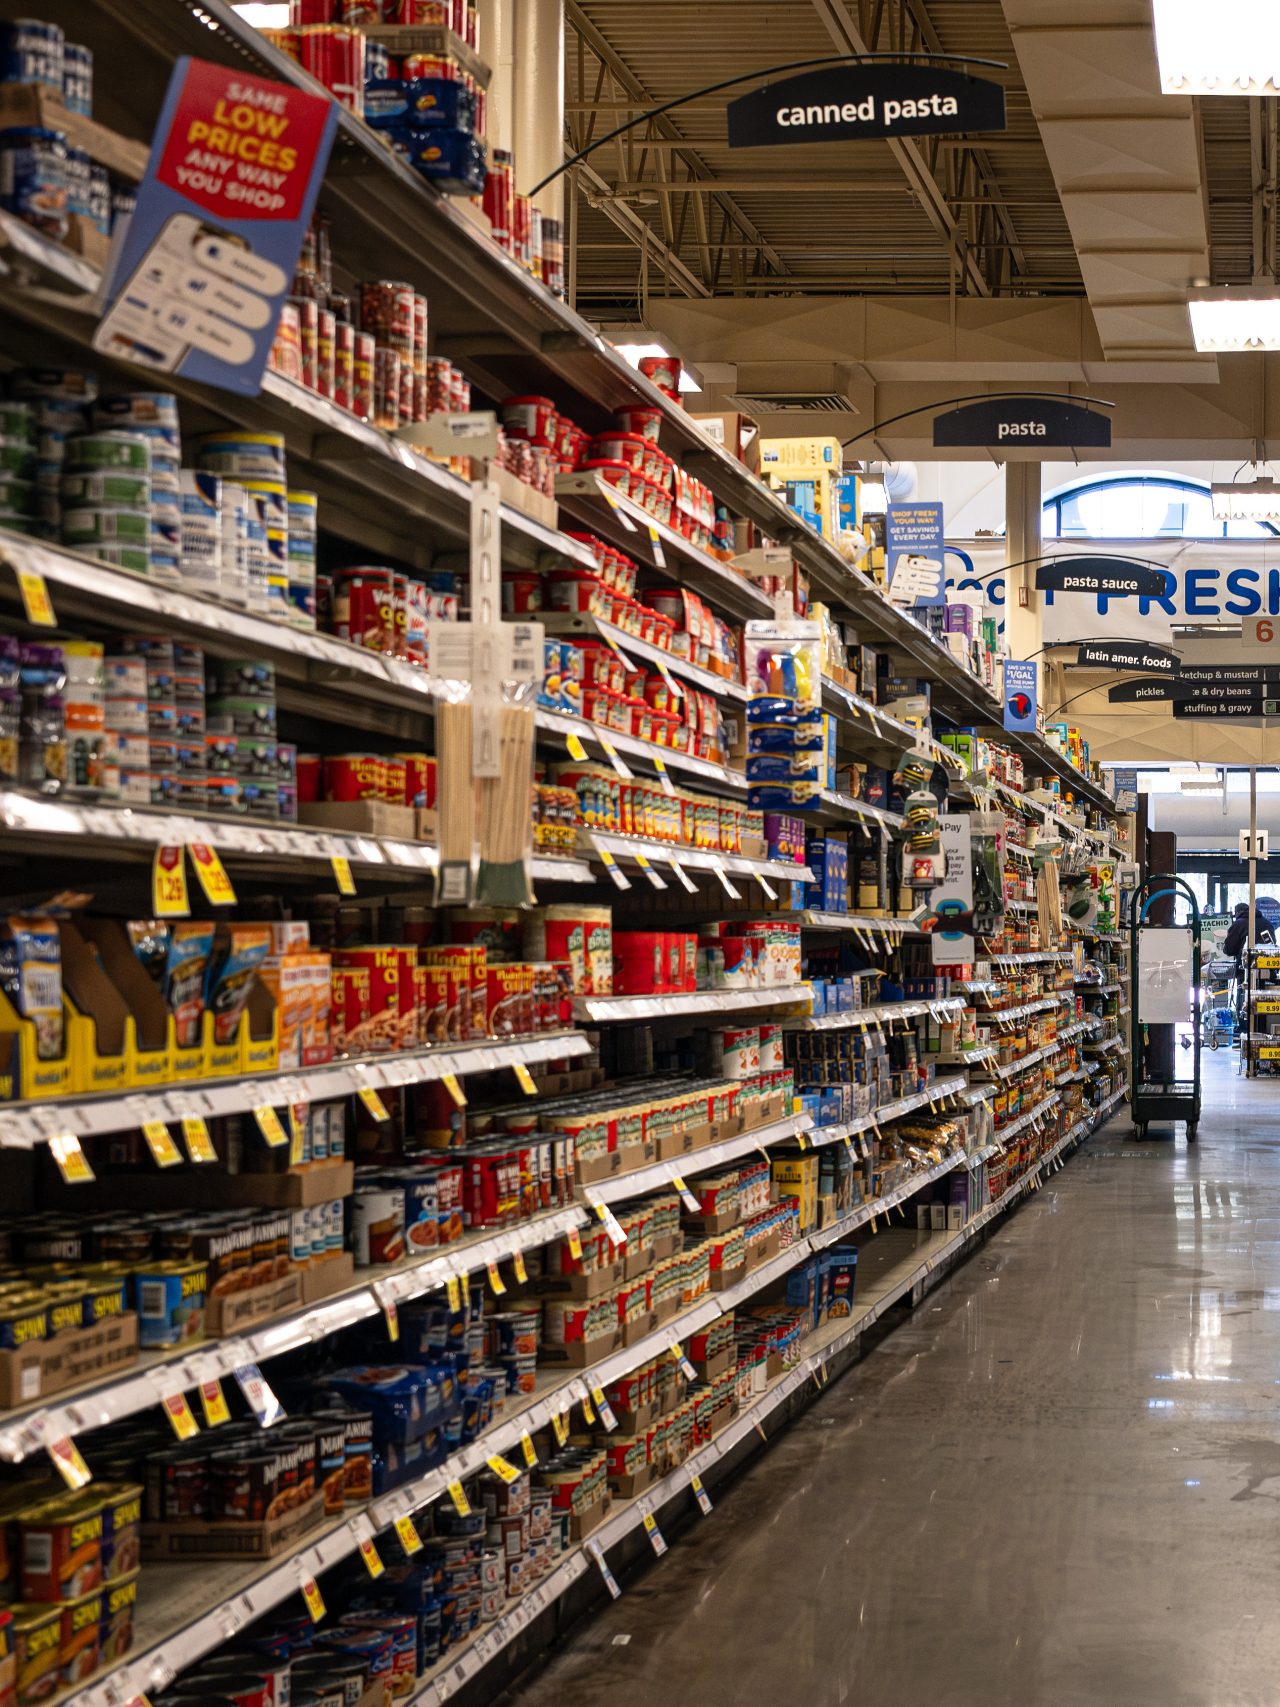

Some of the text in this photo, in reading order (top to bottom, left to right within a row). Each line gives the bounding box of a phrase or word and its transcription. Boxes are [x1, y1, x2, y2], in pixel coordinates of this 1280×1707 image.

[226, 81, 288, 115] SAME
[213, 99, 290, 139] LOW
[776, 94, 958, 127] canned pasta
[186, 120, 299, 172] PRICES
[185, 148, 287, 191] ANY WAY
[175, 166, 286, 211] YOU SHOP
[998, 420, 1046, 440] pasta
[907, 526, 940, 534] SAVINGS
[1063, 575, 1138, 592] pasta sauce
[1255, 620, 1275, 643] 6
[1085, 649, 1172, 669] latin amer. foods
[1180, 669, 1259, 680] ketchup & mustard
[1135, 686, 1165, 698] pickles
[1201, 687, 1209, 696] &
[1210, 687, 1225, 698] dry
[1226, 686, 1251, 696] beans
[1184, 703, 1252, 715] stuffing & gravy
[944, 822, 962, 834] Pay
[1243, 836, 1264, 852] 11
